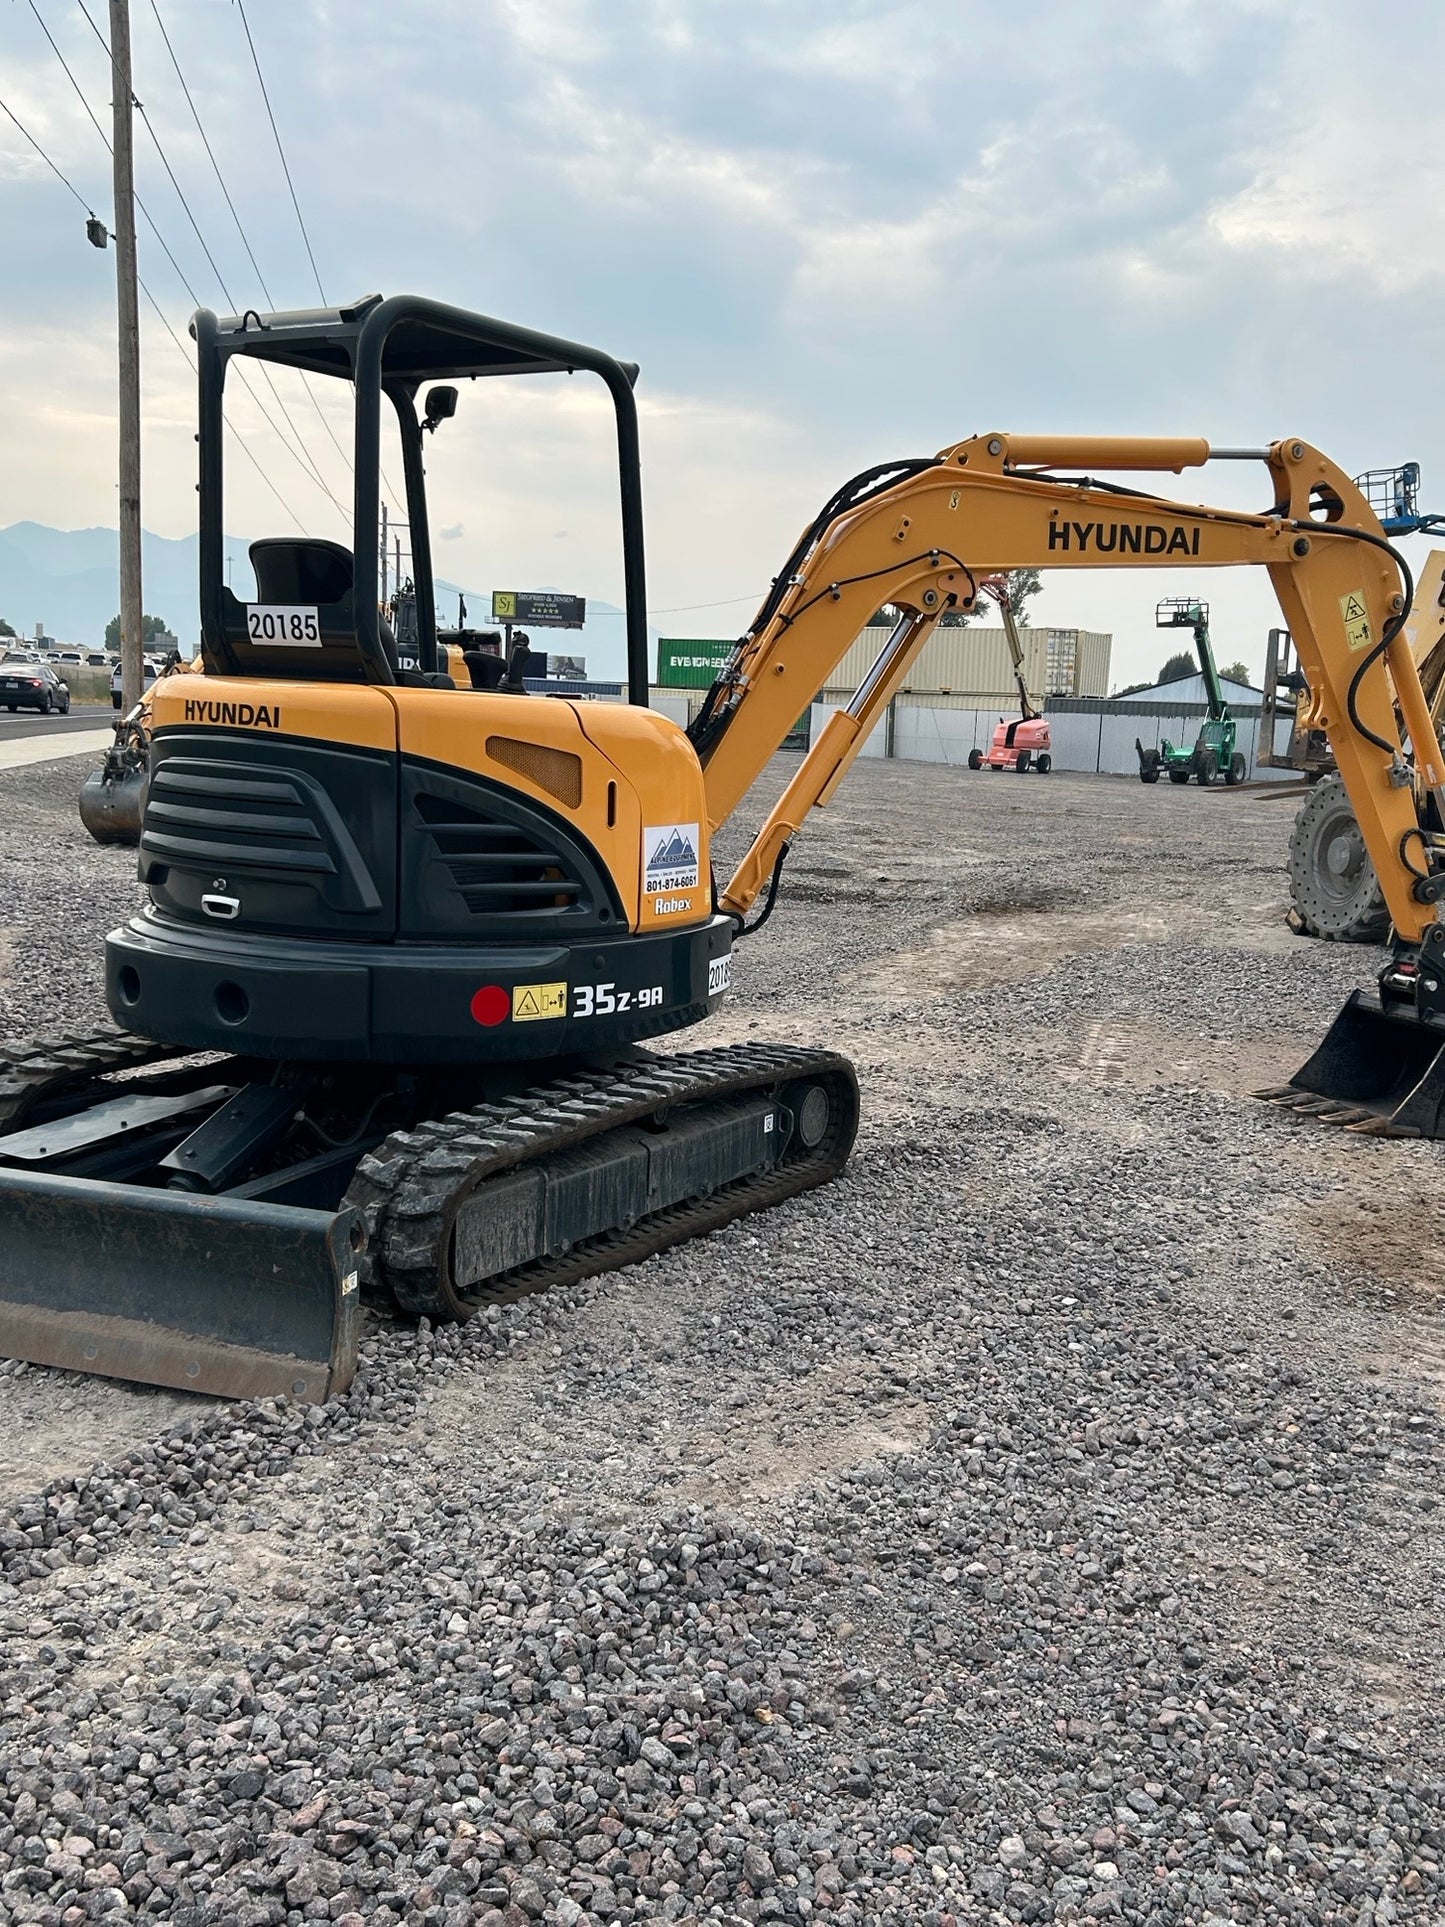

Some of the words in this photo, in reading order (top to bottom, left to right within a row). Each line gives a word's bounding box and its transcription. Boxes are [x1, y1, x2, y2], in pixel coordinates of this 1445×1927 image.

[1048, 521, 1200, 555] HYUNDAI
[499, 597, 512, 613] SJ
[249, 613, 318, 641] 20185
[185, 699, 280, 728] HYUNDAI
[655, 897, 692, 915] Robex
